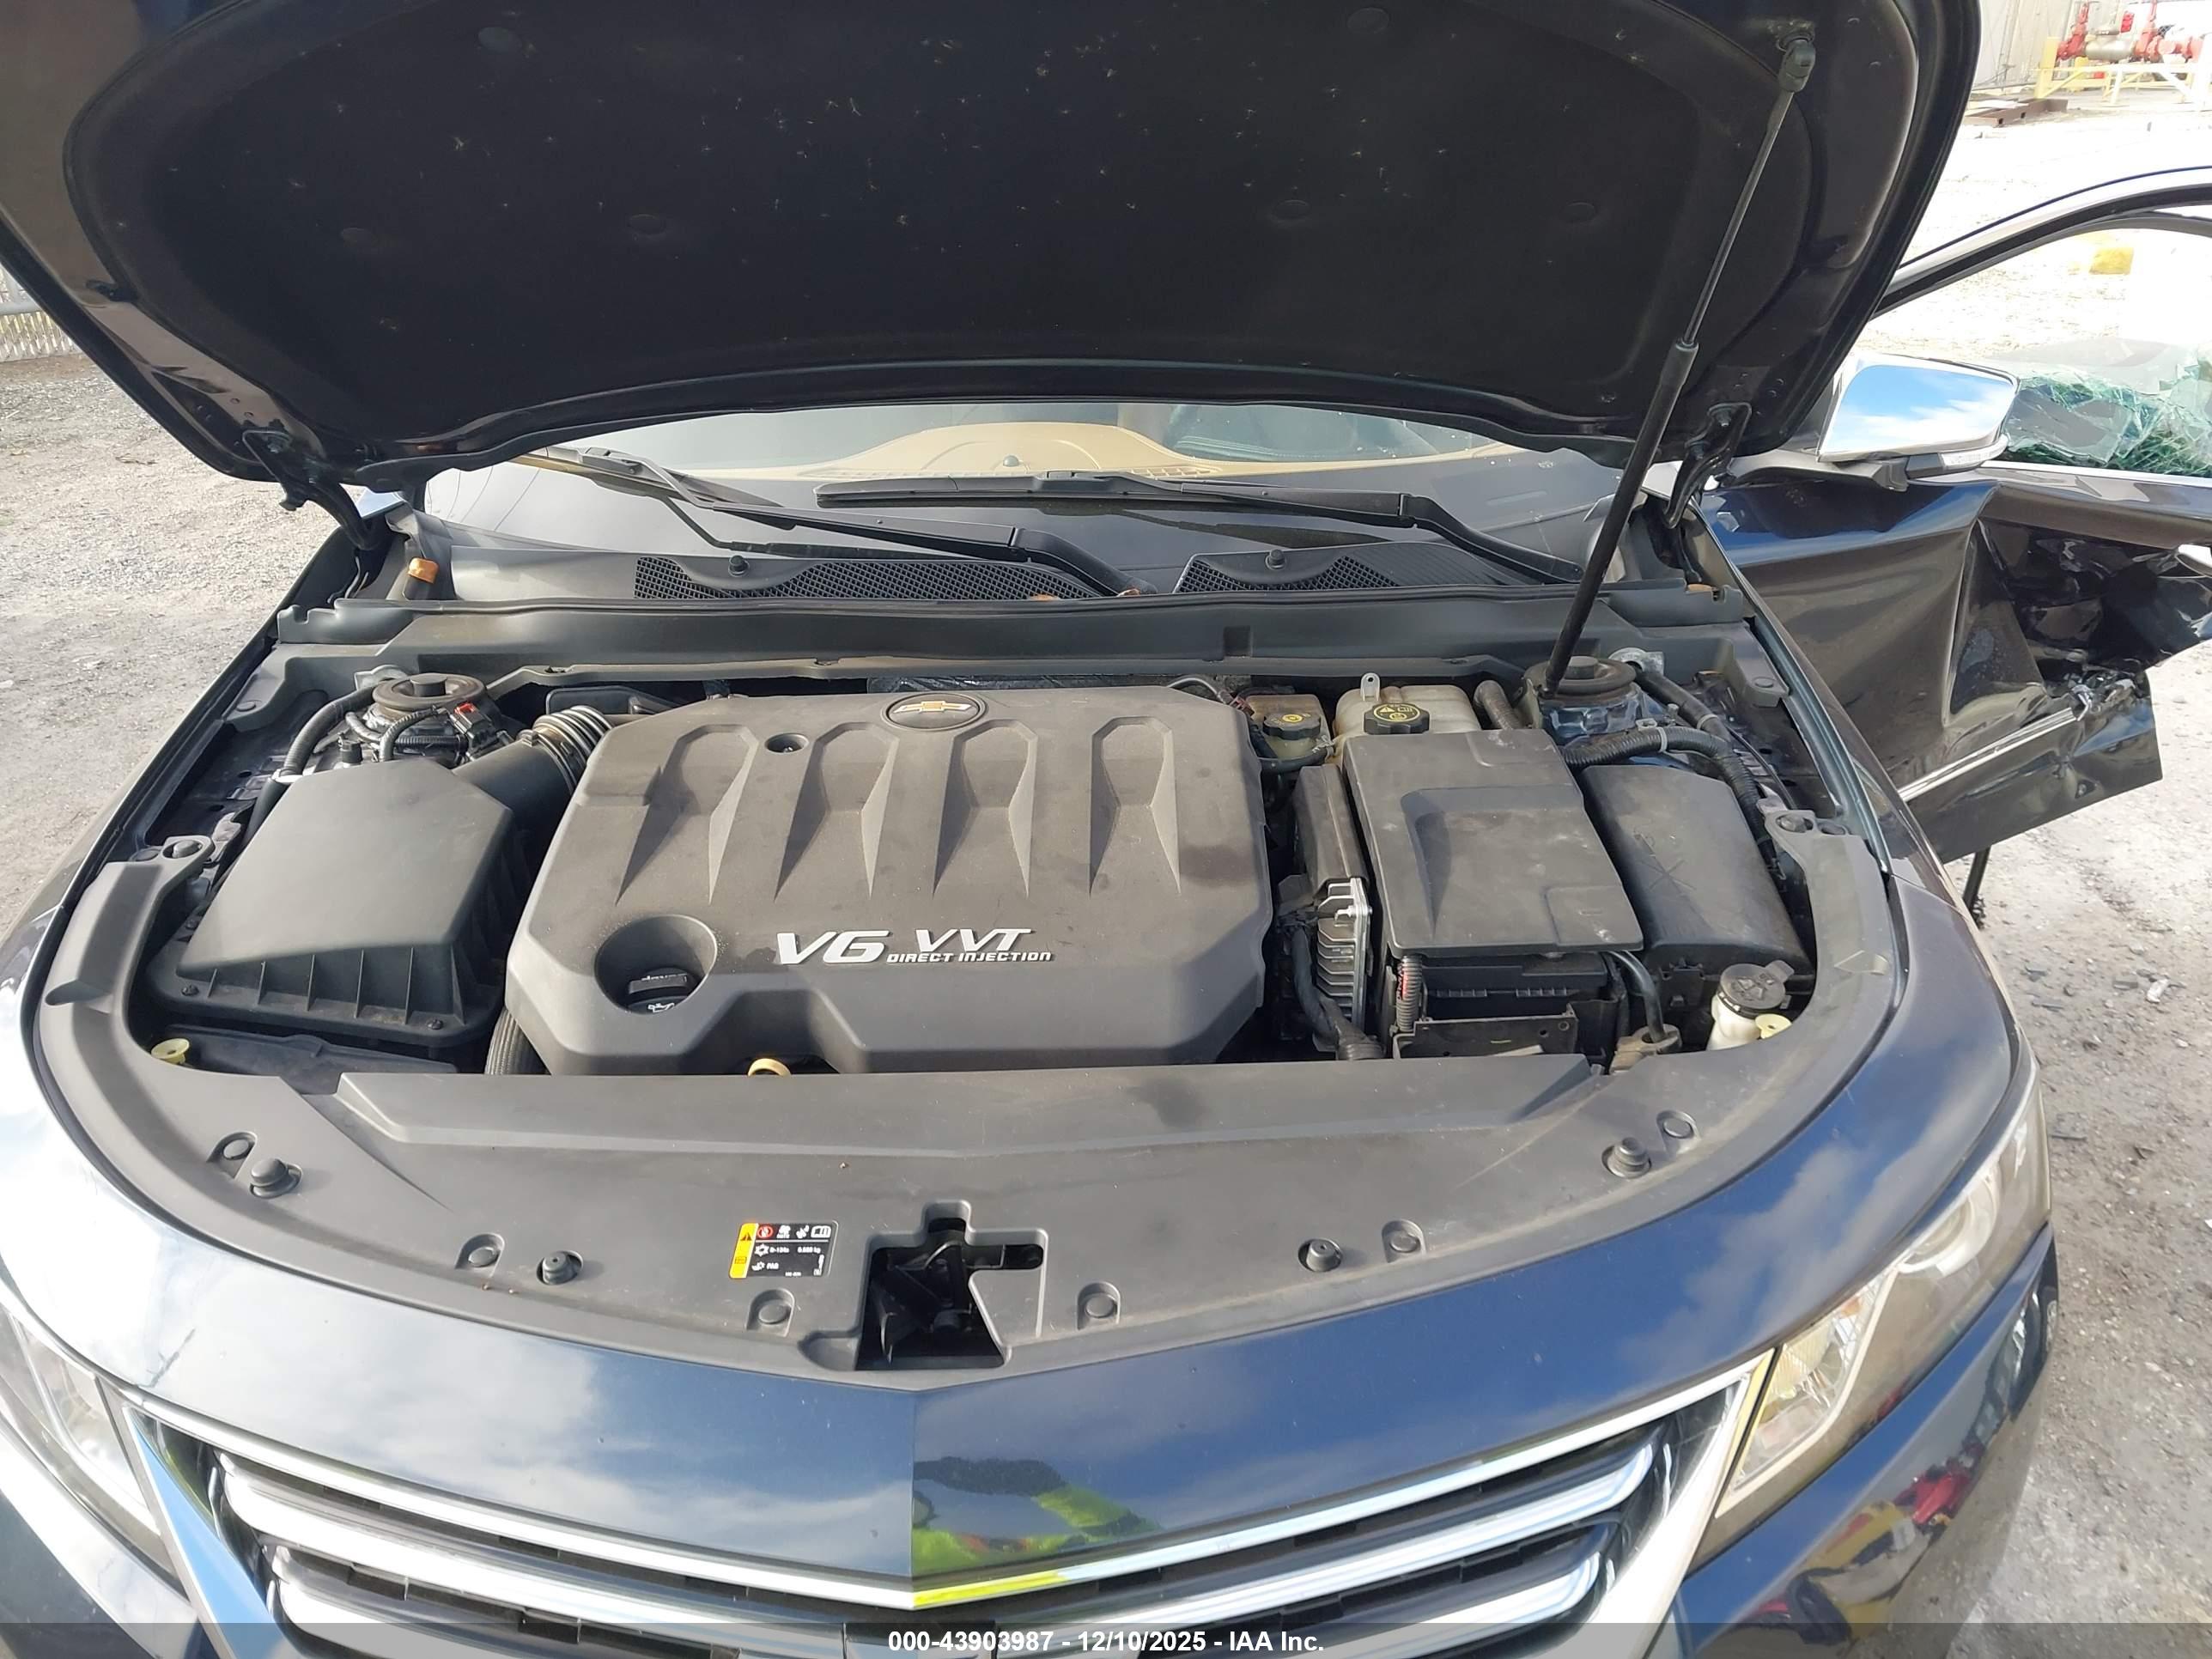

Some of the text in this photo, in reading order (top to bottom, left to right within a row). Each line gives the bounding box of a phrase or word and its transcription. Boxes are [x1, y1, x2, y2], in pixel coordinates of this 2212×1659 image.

[776, 928, 1032, 964] V6 VVT
[886, 951, 1052, 963] DIRECT INJECTION
